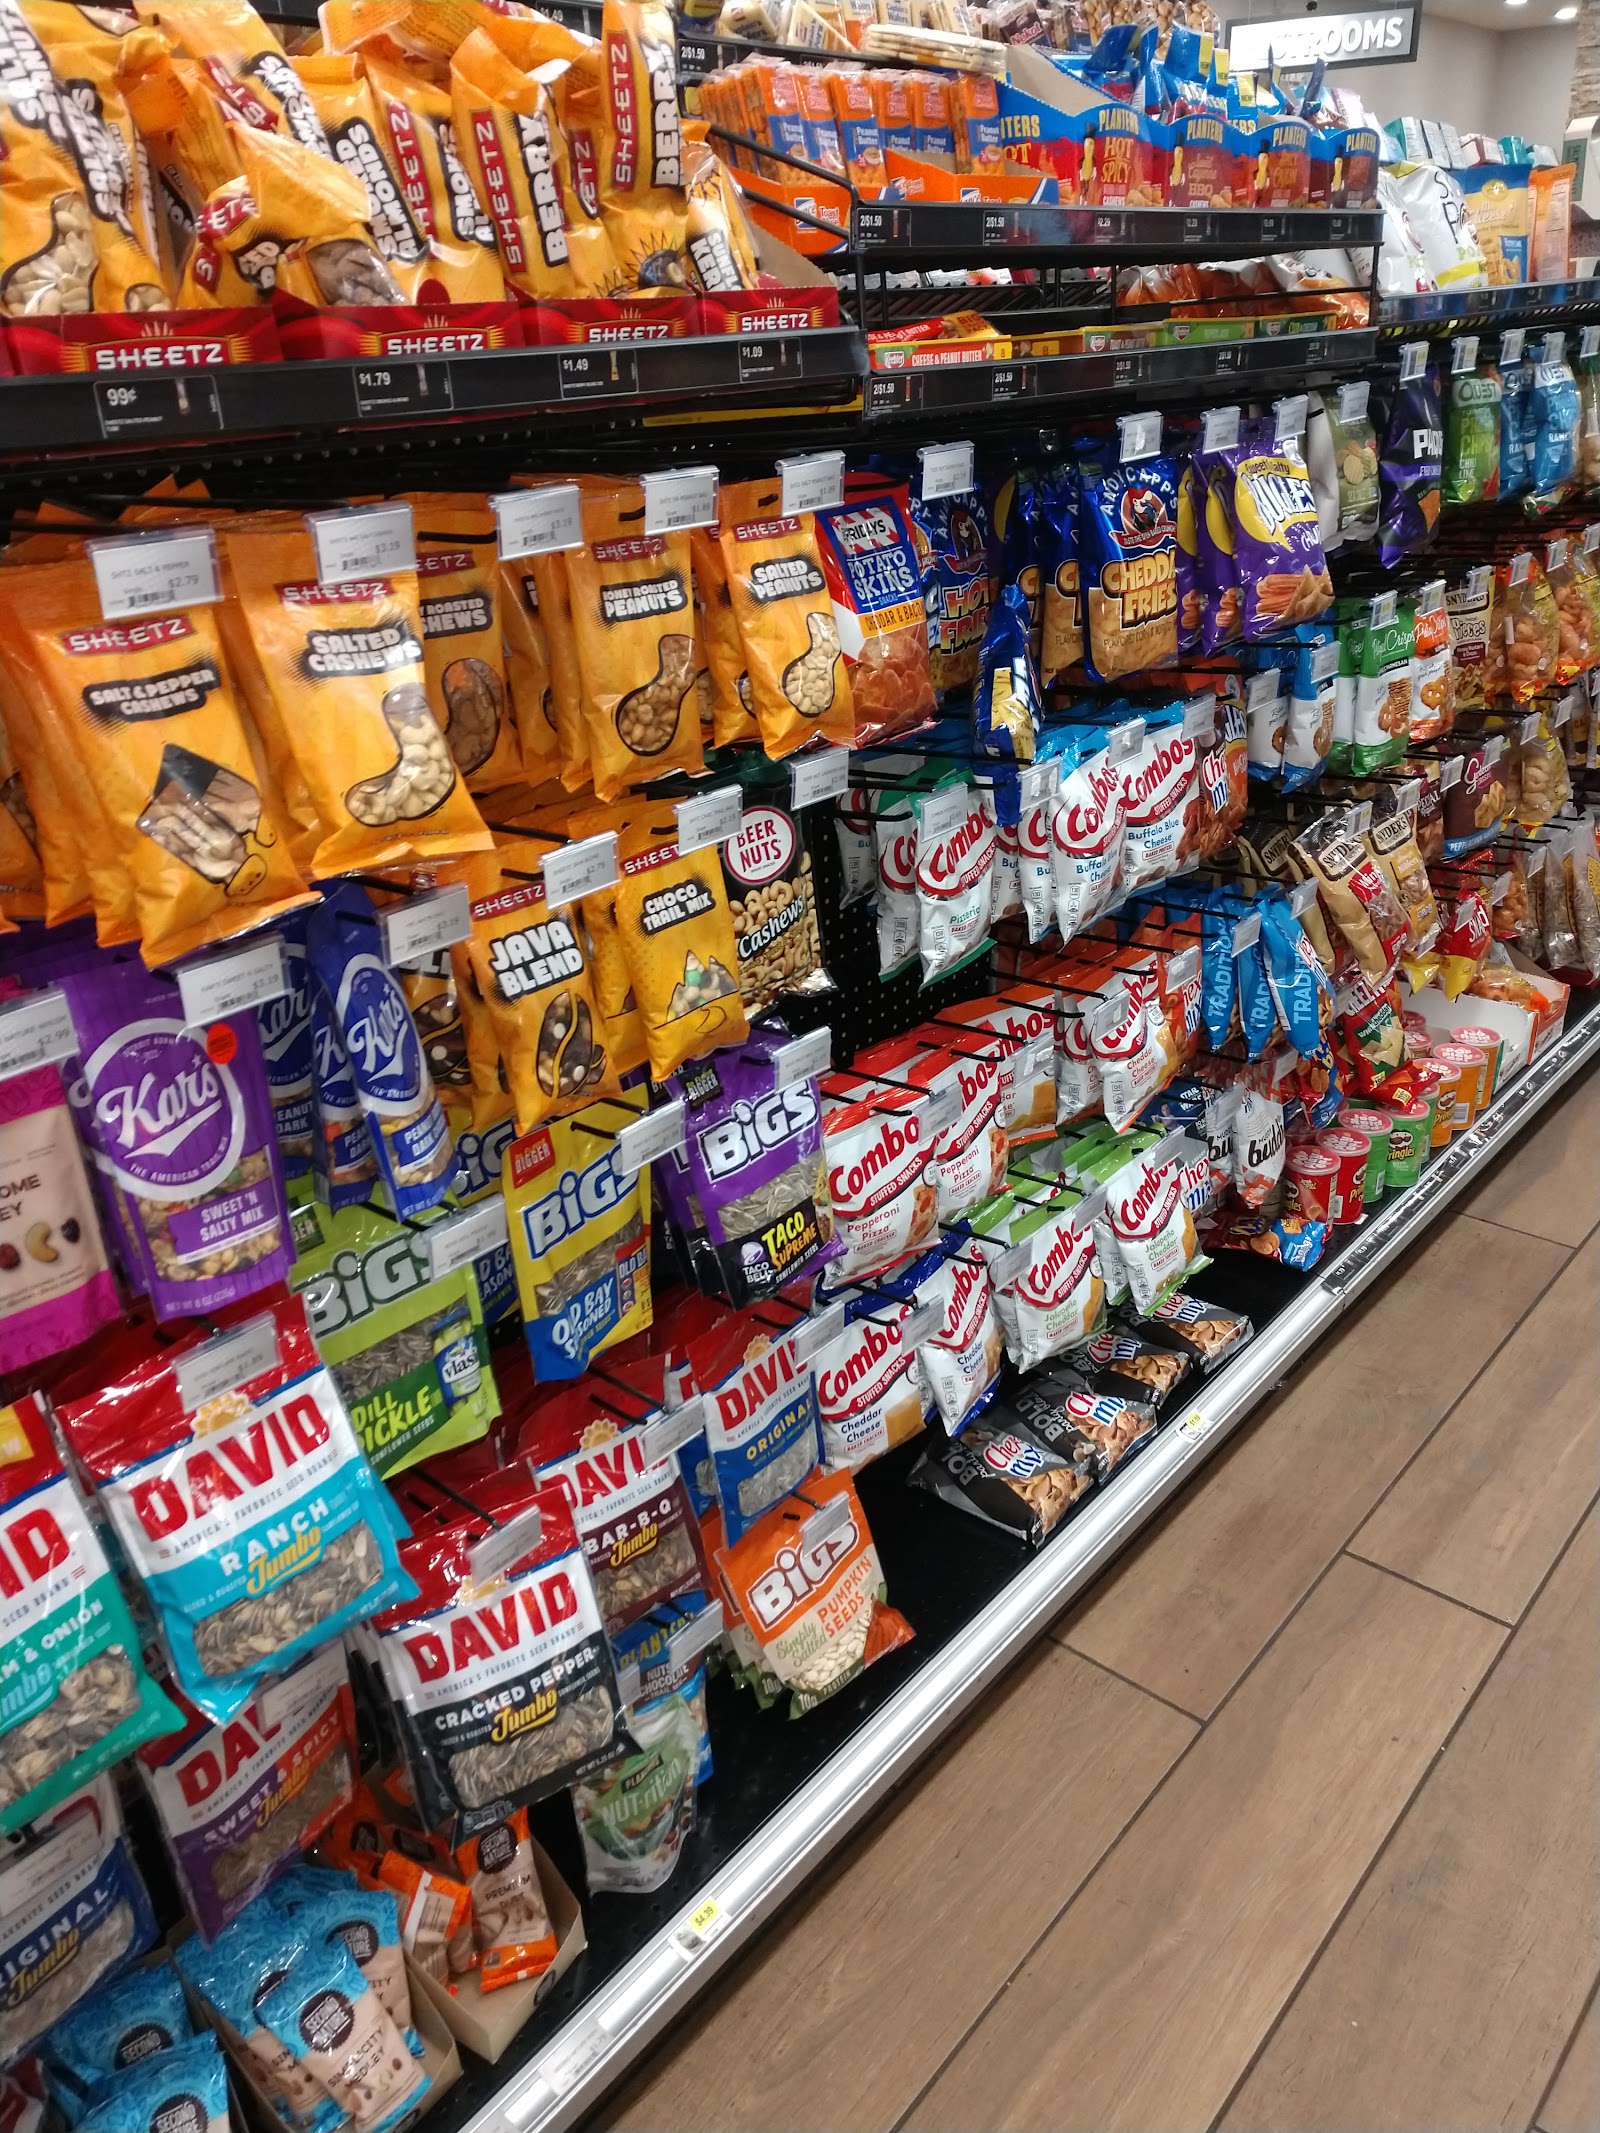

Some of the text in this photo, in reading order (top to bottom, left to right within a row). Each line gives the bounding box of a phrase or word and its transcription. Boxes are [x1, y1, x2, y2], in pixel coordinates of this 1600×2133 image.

[610, 42, 633, 183] SHEETZ
[1099, 108, 1139, 134] PLANTERS
[856, 127, 879, 138] Peanut
[890, 135, 911, 146] Peanut
[1187, 118, 1223, 143] PLANTERS
[1272, 126, 1308, 147] PLANTERS
[1104, 138, 1134, 159] HOT
[517, 113, 568, 262] BERRY
[1101, 161, 1132, 184] SPICY
[475, 119, 524, 266] SHEETZ
[820, 207, 839, 218] Toast
[860, 215, 882, 227] 2/$1.50
[986, 217, 1005, 228] 2/$1.50
[589, 325, 669, 342] SHEETZ
[742, 313, 808, 331] SHEETZ
[956, 312, 984, 326] BIG
[95, 343, 224, 371] SHEETZ
[387, 334, 484, 356] SHEETZ
[742, 346, 763, 359] $1.09
[912, 350, 983, 367] CHEESE & PEANUT BUTTER
[359, 371, 391, 387] $1.79
[562, 358, 589, 372] $1.49
[995, 372, 1013, 383] 2/$1.50
[106, 387, 137, 407] 99¢
[873, 383, 895, 395] 2/$1.50
[1459, 382, 1497, 401] QUEST
[1101, 472, 1126, 516] ANDY
[736, 517, 798, 540] SHEETZ
[595, 538, 663, 559] SHEETZ
[753, 559, 809, 585] SALTED
[847, 551, 908, 580] POTATO
[168, 574, 199, 589] $2.79
[283, 582, 388, 603] SHEETZ
[754, 571, 824, 600] PEANUTS
[854, 566, 915, 602] SKINS
[944, 578, 990, 614] HOT
[427, 598, 485, 615] ROASTED
[604, 590, 684, 618] PEANUTS
[879, 592, 899, 606] SNACKS
[1122, 585, 1178, 623] FRIES
[69, 618, 187, 653] SHEETZ
[311, 628, 401, 655] SALTED
[1450, 618, 1486, 641] Pieces
[308, 640, 422, 673] CASHEWS
[90, 668, 216, 706] SALT & PEPPER
[120, 688, 199, 716] CASHEWS
[1119, 735, 1194, 812] Combos
[1152, 776, 1188, 817] STUFFED SNACKS
[719, 814, 736, 825] $2.19
[736, 818, 777, 848] BEER
[1127, 817, 1180, 841] Buffalo Blue
[928, 802, 994, 882] Combo
[1143, 833, 1172, 850] Cheese
[624, 844, 679, 875] SHEET
[739, 841, 782, 873] NUTS
[474, 885, 545, 917] SHEETZ
[642, 892, 714, 932] TRAIL MIX
[644, 883, 698, 915] CHOCO
[737, 892, 805, 959] Cashews
[949, 905, 982, 925] Pizzeria
[491, 921, 576, 971] JAVA
[498, 947, 584, 998] BLEND
[37, 1029, 70, 1046] $2.99
[1131, 1056, 1156, 1079] Cheese
[687, 1075, 720, 1102] BIGGER
[1180, 1086, 1199, 1100] STAR
[701, 1078, 817, 1181] BiGS
[955, 1100, 994, 1150] STUFFED SNACKS
[513, 1145, 551, 1174] BIGGER
[827, 1116, 920, 1204] Combo
[940, 1145, 980, 1178] Pepperoni
[953, 1165, 975, 1183] Pizza
[869, 1156, 923, 1207] STUFFED SNACKS
[201, 1197, 243, 1224] SWEET
[846, 1203, 900, 1234] Pepperoni
[1154, 1186, 1178, 1230] STUFFED SNACKS
[200, 1205, 266, 1242] SALTY MIX
[760, 1211, 805, 1255] TACO
[861, 1223, 891, 1242] Pizza
[770, 1225, 817, 1272] SUPREME
[1144, 1227, 1176, 1254] Jalapeño
[1148, 1237, 1178, 1262] Cheddar
[741, 1262, 770, 1276] TACO
[775, 1242, 820, 1285] SUNFLOWER SEEDS
[1056, 1252, 1089, 1299] STUFFED SNACKS
[966, 1291, 989, 1340] STUFFED SNACKS
[1044, 1298, 1078, 1324] Jalapeño
[1046, 1307, 1079, 1332] Cheddar
[957, 1339, 983, 1366] Cheddar
[963, 1352, 984, 1375] Cheese
[856, 1357, 907, 1408] STUFFED SNACKS
[350, 1390, 400, 1431] DILL
[840, 1406, 883, 1434] Cheddar
[370, 1414, 435, 1466] SUNFLOWER SEEDS
[846, 1419, 881, 1444] Cheese
[128, 1393, 331, 1542] DAVID
[983, 1432, 1023, 1473] Chex
[233, 1487, 284, 1526] FAVORITE
[285, 1470, 306, 1494] SEED
[218, 1495, 331, 1577] RANCH
[585, 1498, 673, 1555] BAR-B-Q
[610, 1521, 659, 1568] Jumbo
[246, 1525, 323, 1597] Jumbo
[815, 1554, 874, 1624] PUMPKIN
[24, 1598, 105, 1662] & ONION
[403, 1570, 580, 1685] DAVID
[824, 1590, 866, 1640] SEEDS
[775, 1618, 818, 1660] Simply
[792, 1629, 828, 1668] Salted
[436, 1625, 577, 1698] AMERICA'S FAVORITE SEED BRAND
[434, 1649, 592, 1732] CRACKED PEPPER
[798, 1671, 850, 1712] 10g PROTEIN
[490, 1688, 559, 1744] Jumbo
[203, 1780, 273, 1843] SWEET
[292, 1710, 340, 1766] SPICY
[255, 1757, 312, 1828] Jumbo
[481, 1826, 510, 1854] SECOND
[694, 1905, 714, 1927] $4.39
[309, 1995, 340, 2035] SECOND
[312, 2010, 351, 2050] NATURE
[120, 2030, 163, 2065] SECOND
